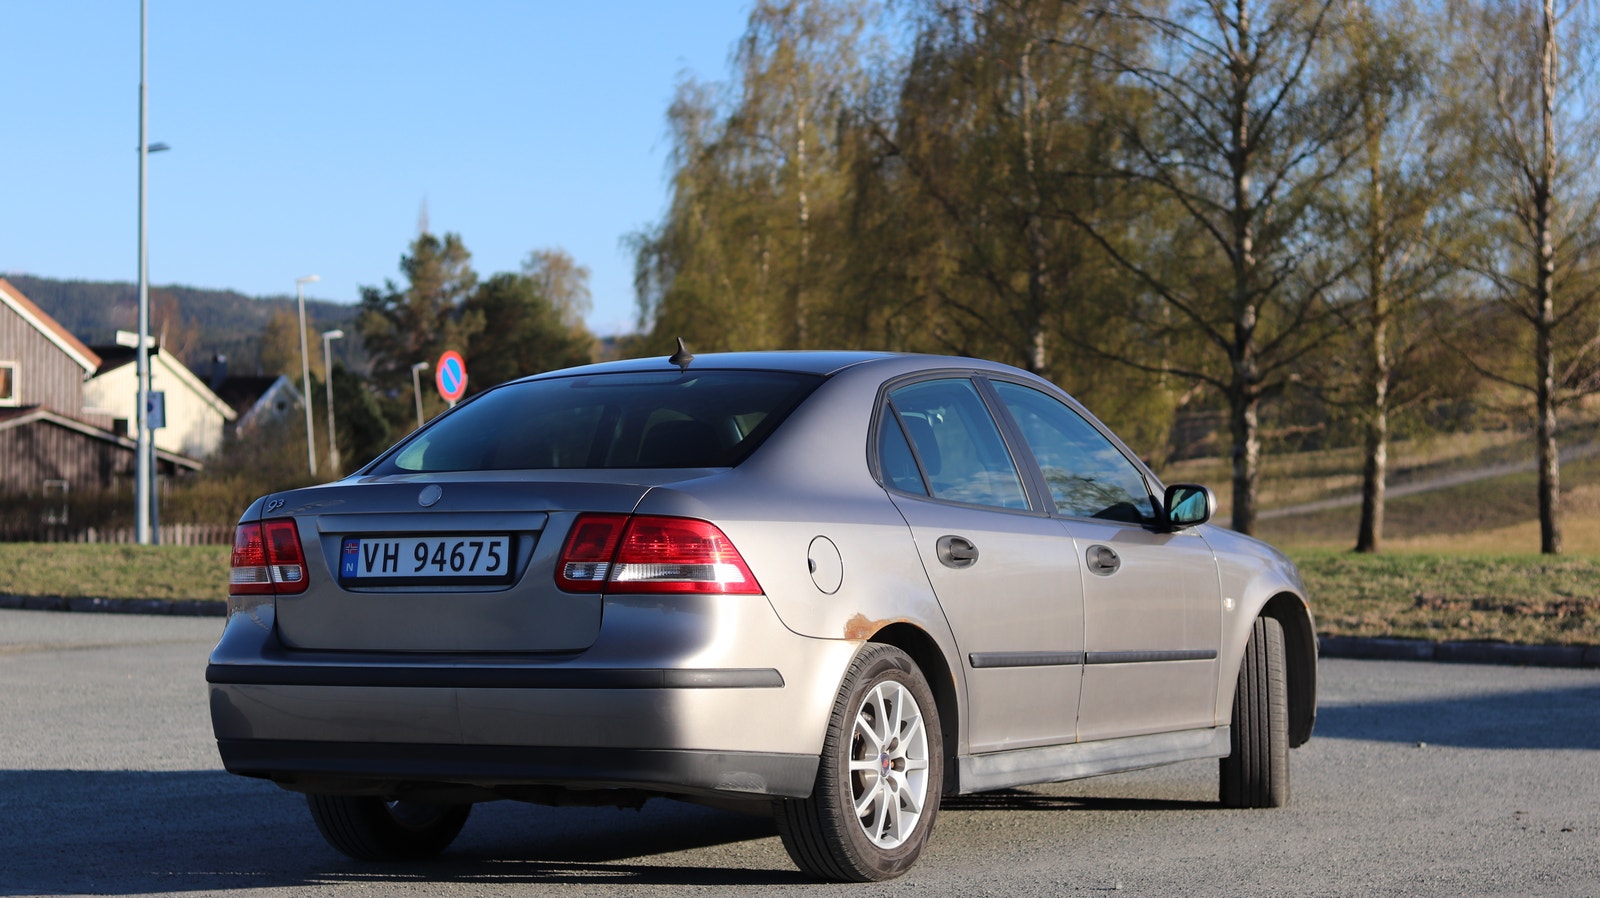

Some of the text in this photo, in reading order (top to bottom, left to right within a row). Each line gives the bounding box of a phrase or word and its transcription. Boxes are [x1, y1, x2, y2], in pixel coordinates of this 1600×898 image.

[345, 562, 354, 572] N
[363, 541, 502, 573] VH 94675
